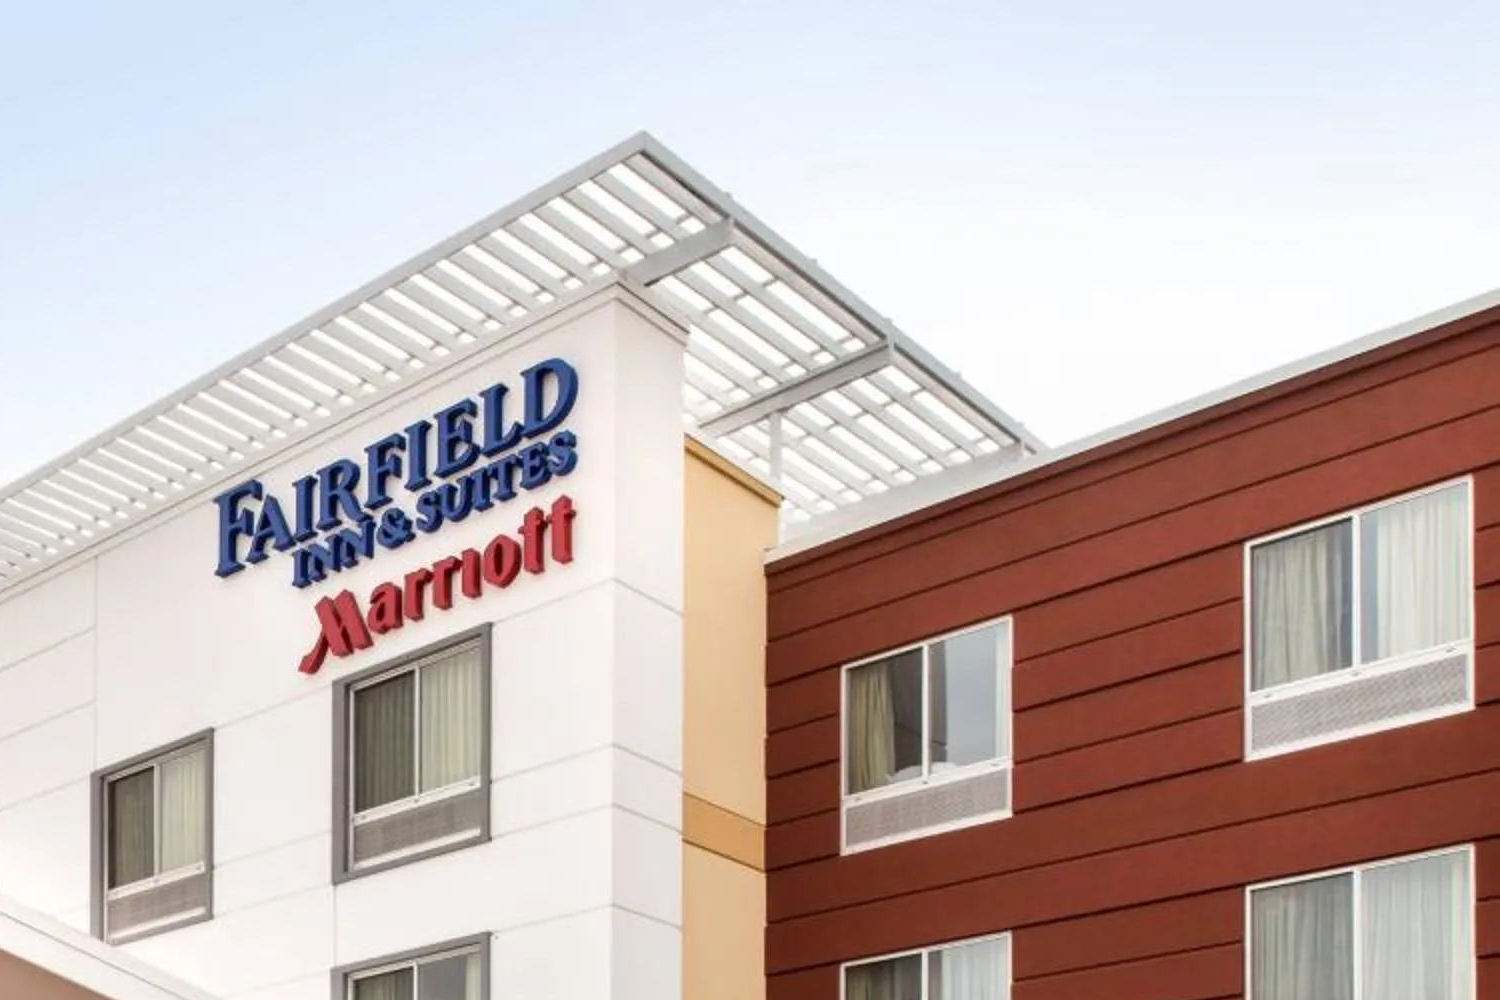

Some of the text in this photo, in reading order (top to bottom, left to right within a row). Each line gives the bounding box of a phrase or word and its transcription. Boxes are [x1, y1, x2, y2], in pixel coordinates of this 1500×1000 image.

[213, 357, 579, 577] FAIRFIELD
[292, 519, 376, 588] INN
[416, 430, 578, 532] SUITES
[298, 494, 576, 674] Marriott
